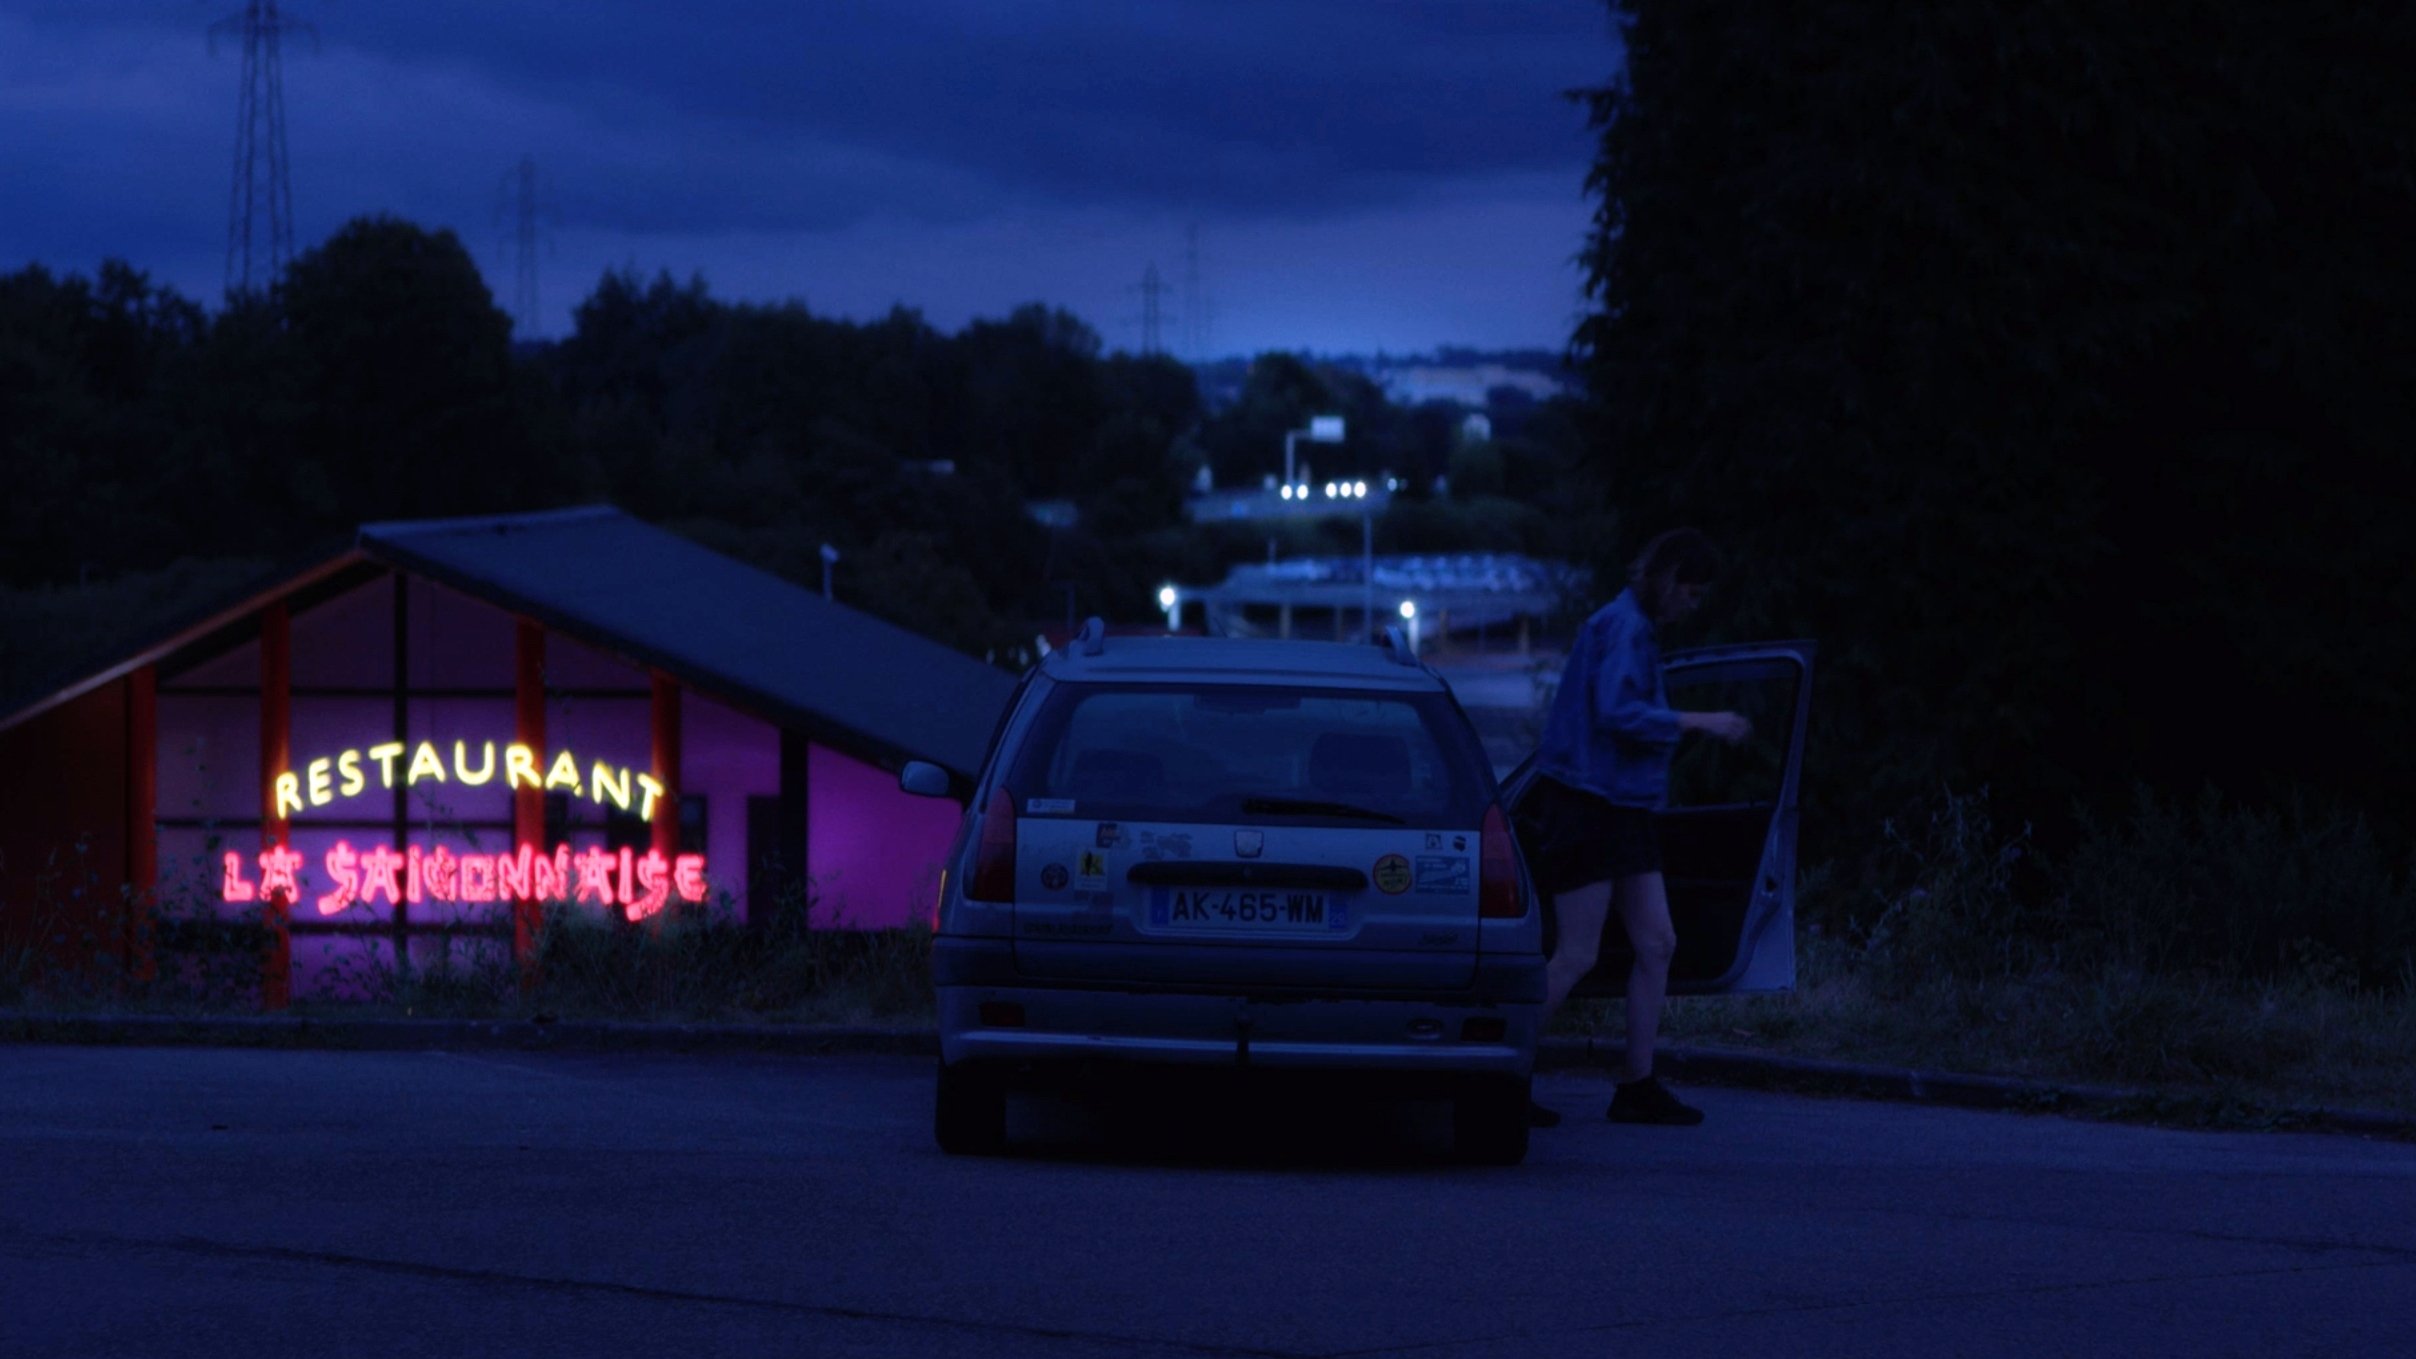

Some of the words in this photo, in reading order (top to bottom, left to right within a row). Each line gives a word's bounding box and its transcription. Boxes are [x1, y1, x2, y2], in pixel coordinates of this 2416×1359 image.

[275, 740, 665, 821] RESTAURANT
[222, 845, 302, 902] LA
[318, 841, 706, 921] SAIGONNAISE
[1172, 892, 1324, 924] AK-465-WM
